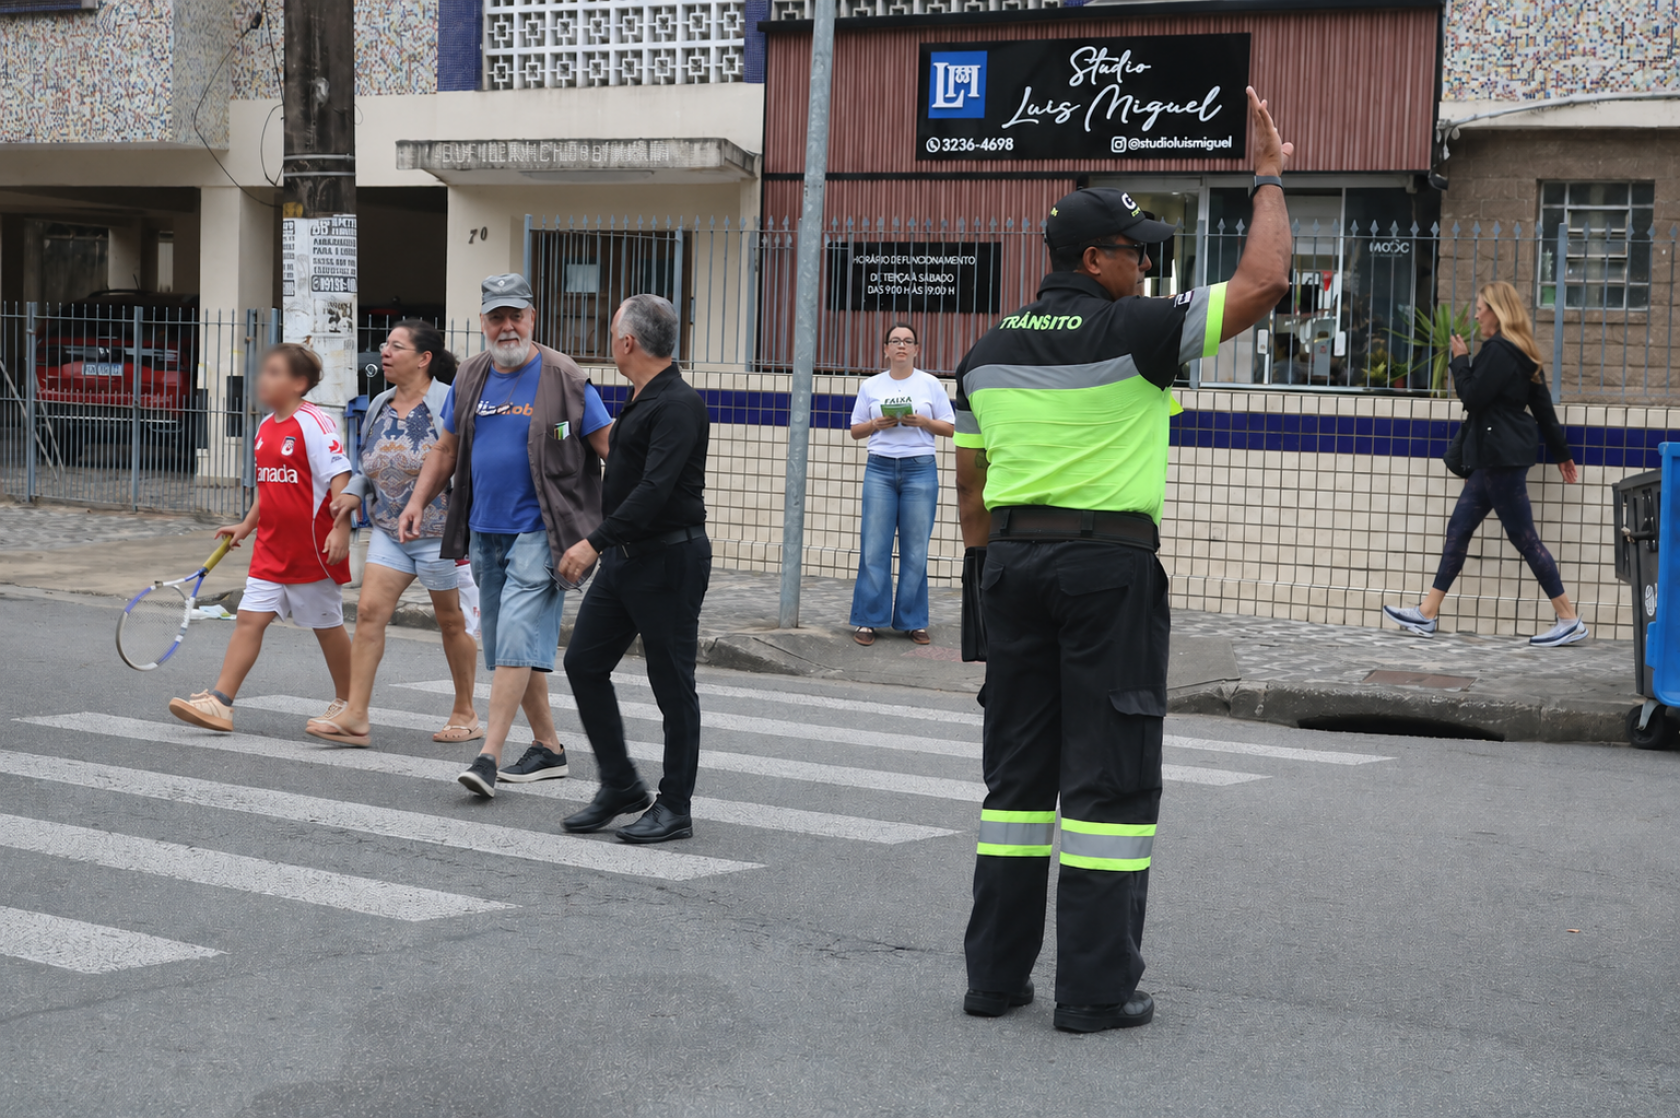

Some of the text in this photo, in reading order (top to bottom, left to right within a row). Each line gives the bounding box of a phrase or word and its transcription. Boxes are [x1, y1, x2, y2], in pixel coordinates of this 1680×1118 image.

[1069, 46, 1151, 86] Studio
[1002, 84, 1222, 132] Luis Miguel
[942, 137, 1014, 151] 3236-4698
[1128, 136, 1232, 151] @studioluismiguel
[468, 226, 488, 245] 70
[867, 284, 884, 295] DAS
[948, 286, 956, 295] H
[884, 396, 912, 404] FAIXA
